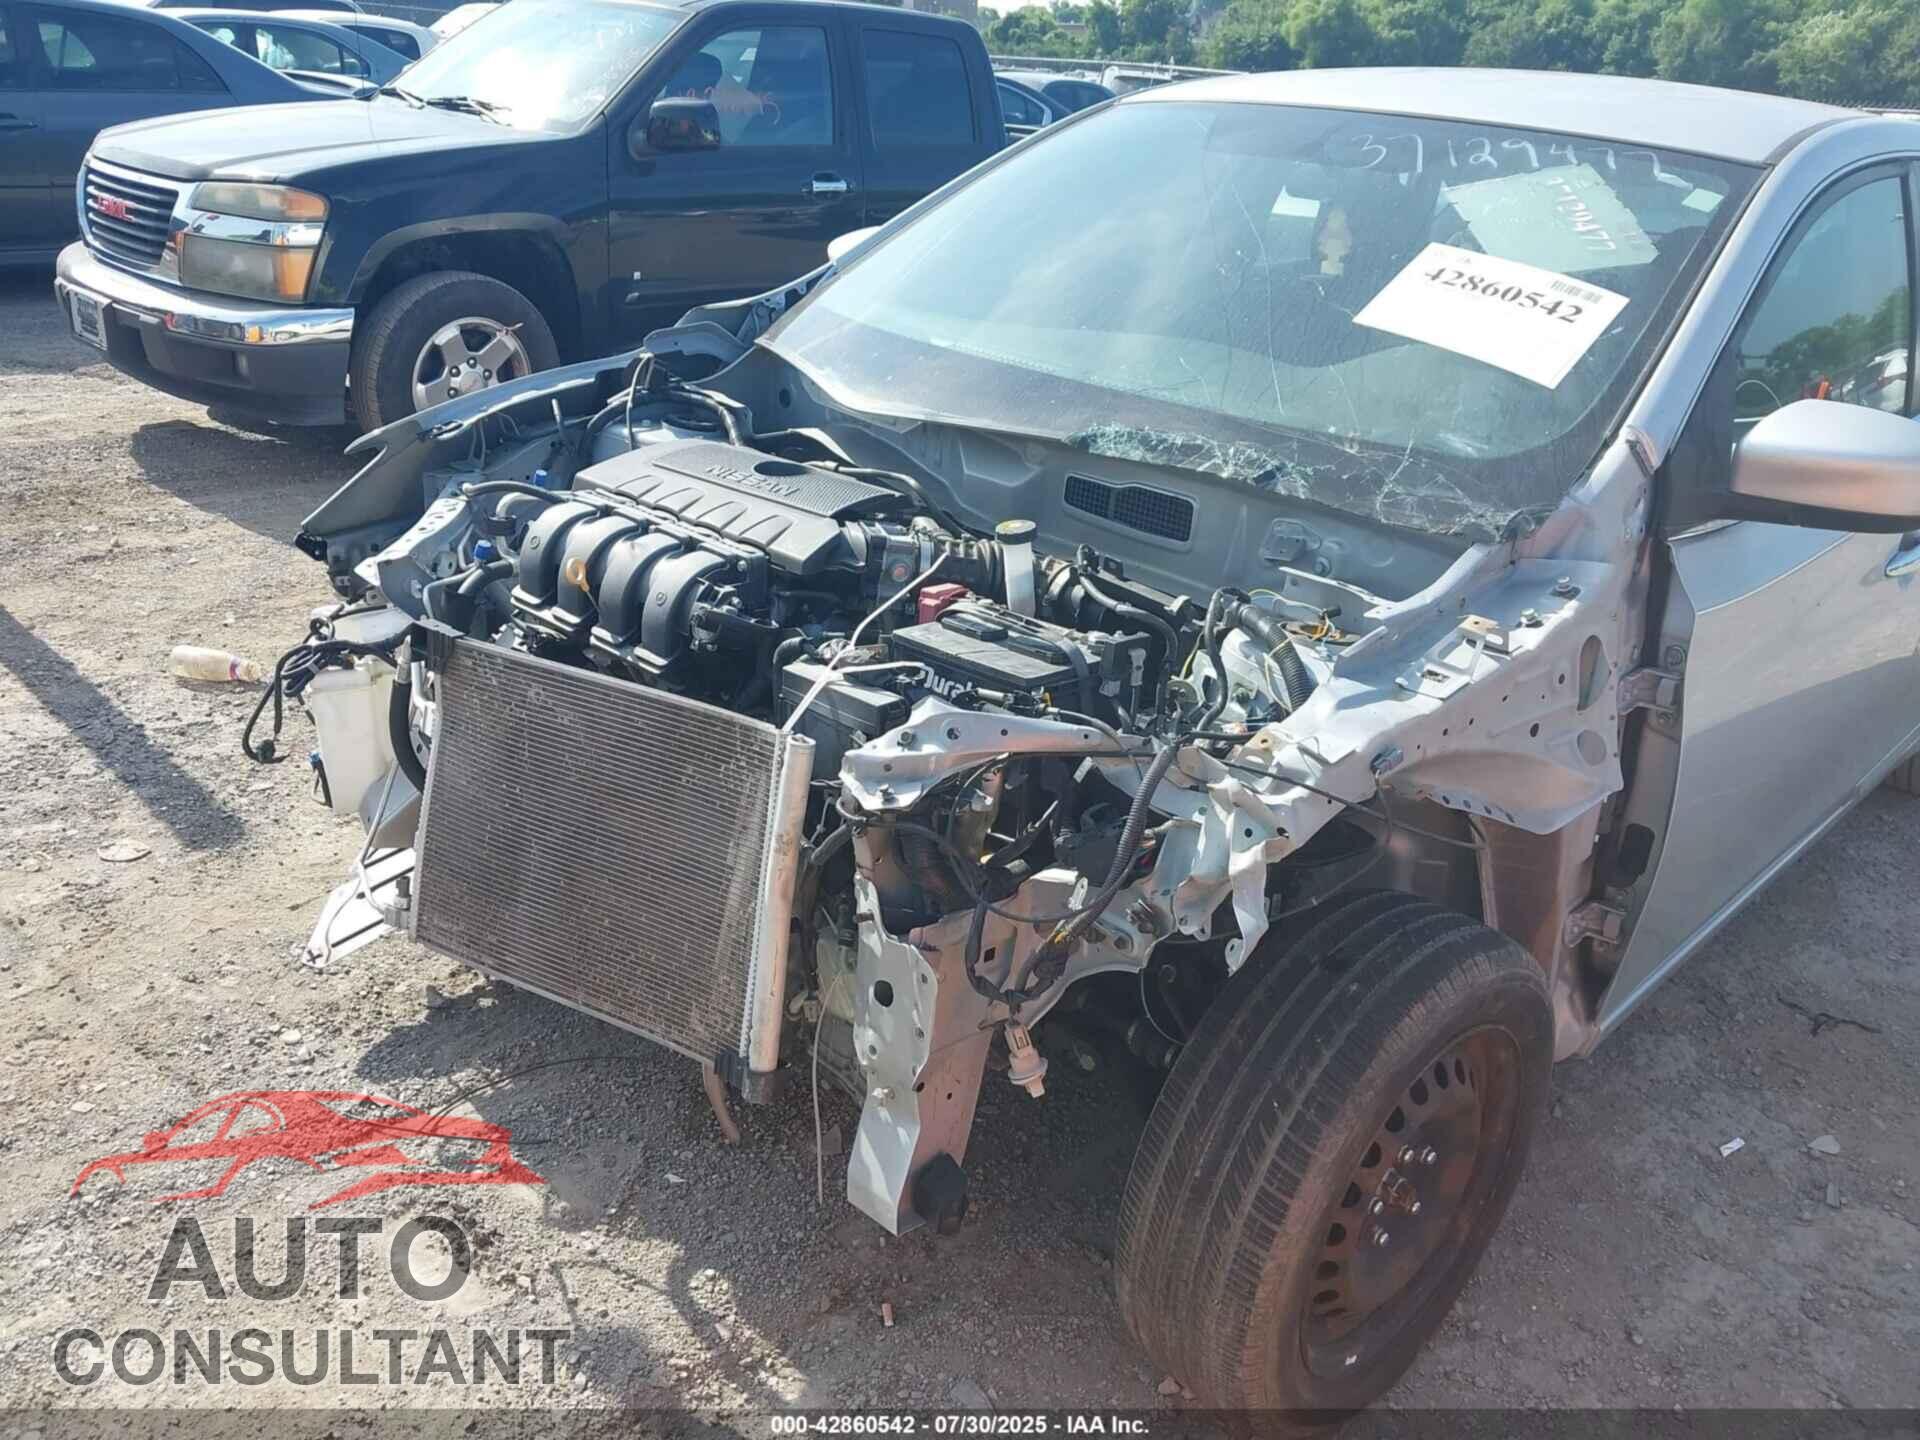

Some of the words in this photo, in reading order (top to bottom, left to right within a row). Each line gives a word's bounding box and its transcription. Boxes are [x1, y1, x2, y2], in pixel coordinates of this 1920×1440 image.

[1351, 133, 1662, 180] 37129477
[96, 194, 135, 222] GMC
[1425, 267, 1583, 324] 42860542
[705, 463, 801, 497] NISSAN
